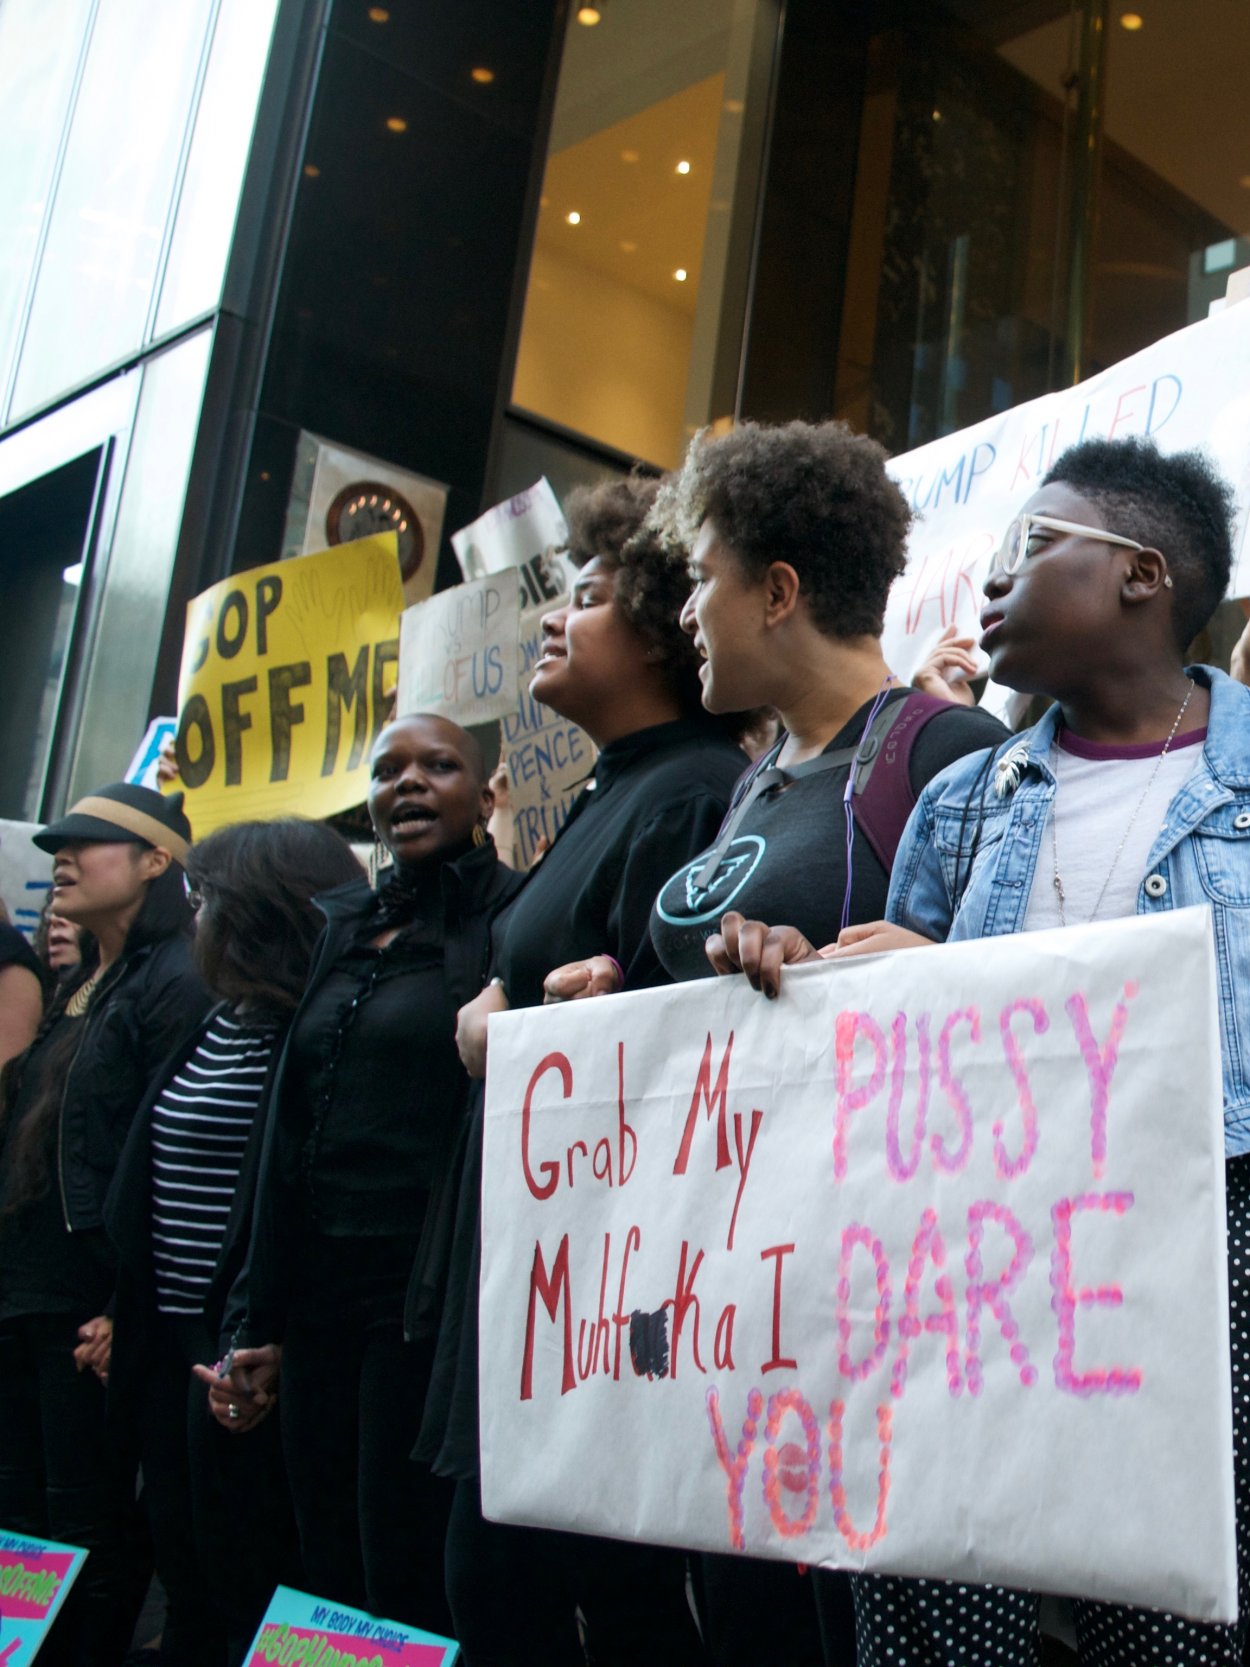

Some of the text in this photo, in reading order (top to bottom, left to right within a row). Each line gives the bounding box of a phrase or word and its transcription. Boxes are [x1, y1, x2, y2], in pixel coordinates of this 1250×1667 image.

[174, 661, 312, 789] OFF
[320, 638, 399, 778] ME
[444, 655, 472, 705] OF
[472, 644, 504, 699] US
[508, 727, 584, 788] PENCE
[521, 980, 1140, 1251] Grab My PUSSY
[760, 1243, 798, 1374] I
[836, 1192, 1145, 1401] DARE
[706, 1385, 893, 1553] YOU
[310, 1605, 328, 1626] MY
[328, 1611, 358, 1634] BODY
[355, 1620, 375, 1639] MY
